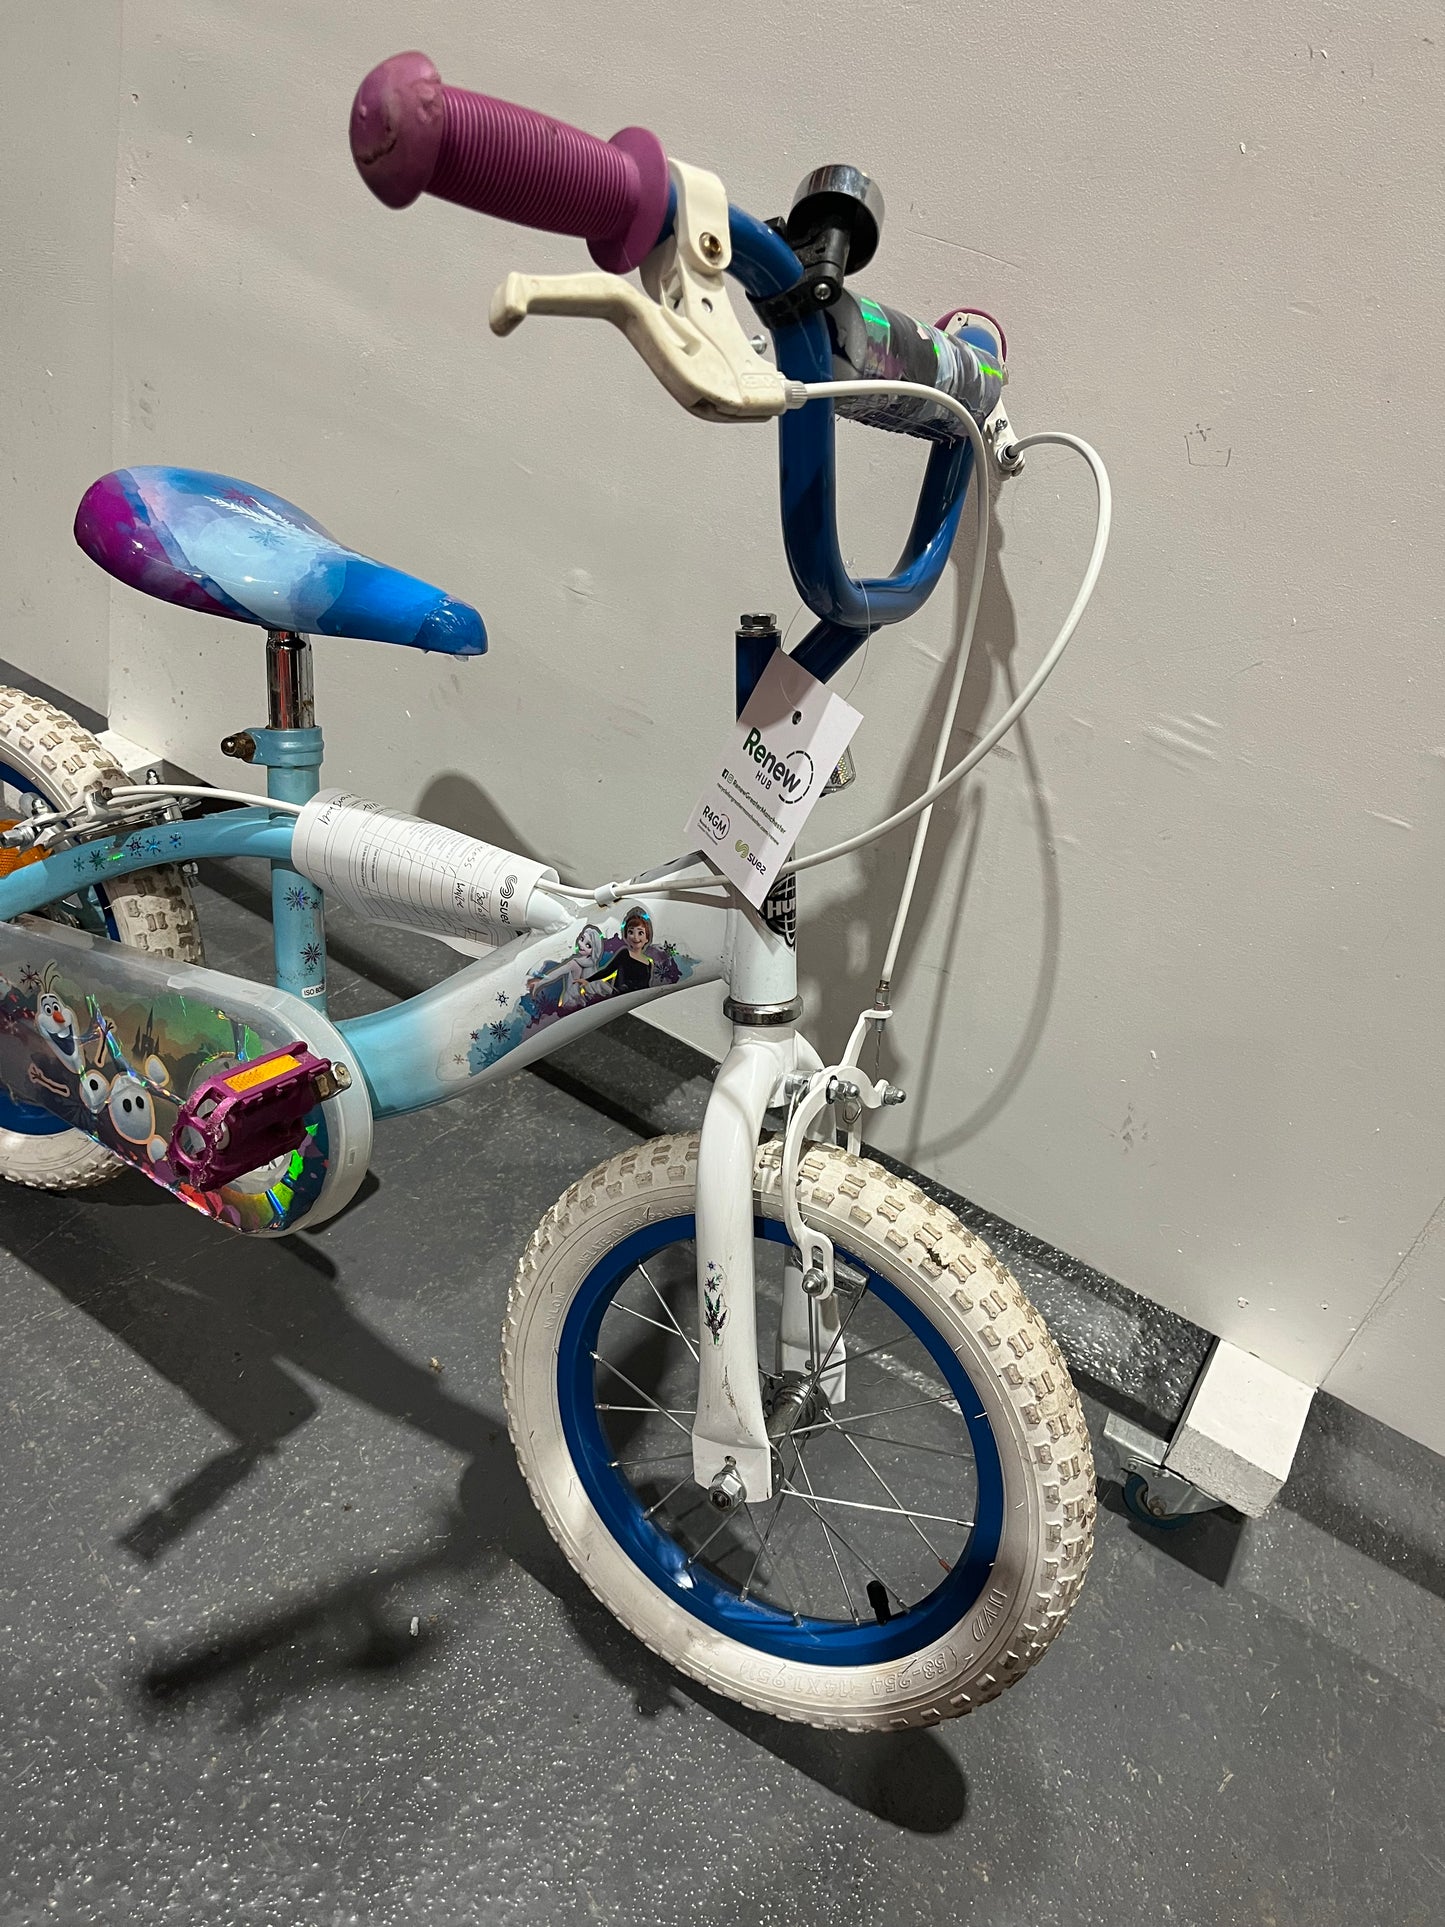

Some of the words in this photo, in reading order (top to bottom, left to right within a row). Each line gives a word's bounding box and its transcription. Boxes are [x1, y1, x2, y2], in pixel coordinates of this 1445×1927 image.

[743, 727, 802, 793] Renew
[755, 770, 773, 790] HUB
[702, 805, 727, 835] R4GM
[747, 853, 767, 876] suez
[303, 988, 315, 996] ISO
[543, 1291, 566, 1329] NYLON
[870, 1652, 948, 1696] 53-254
